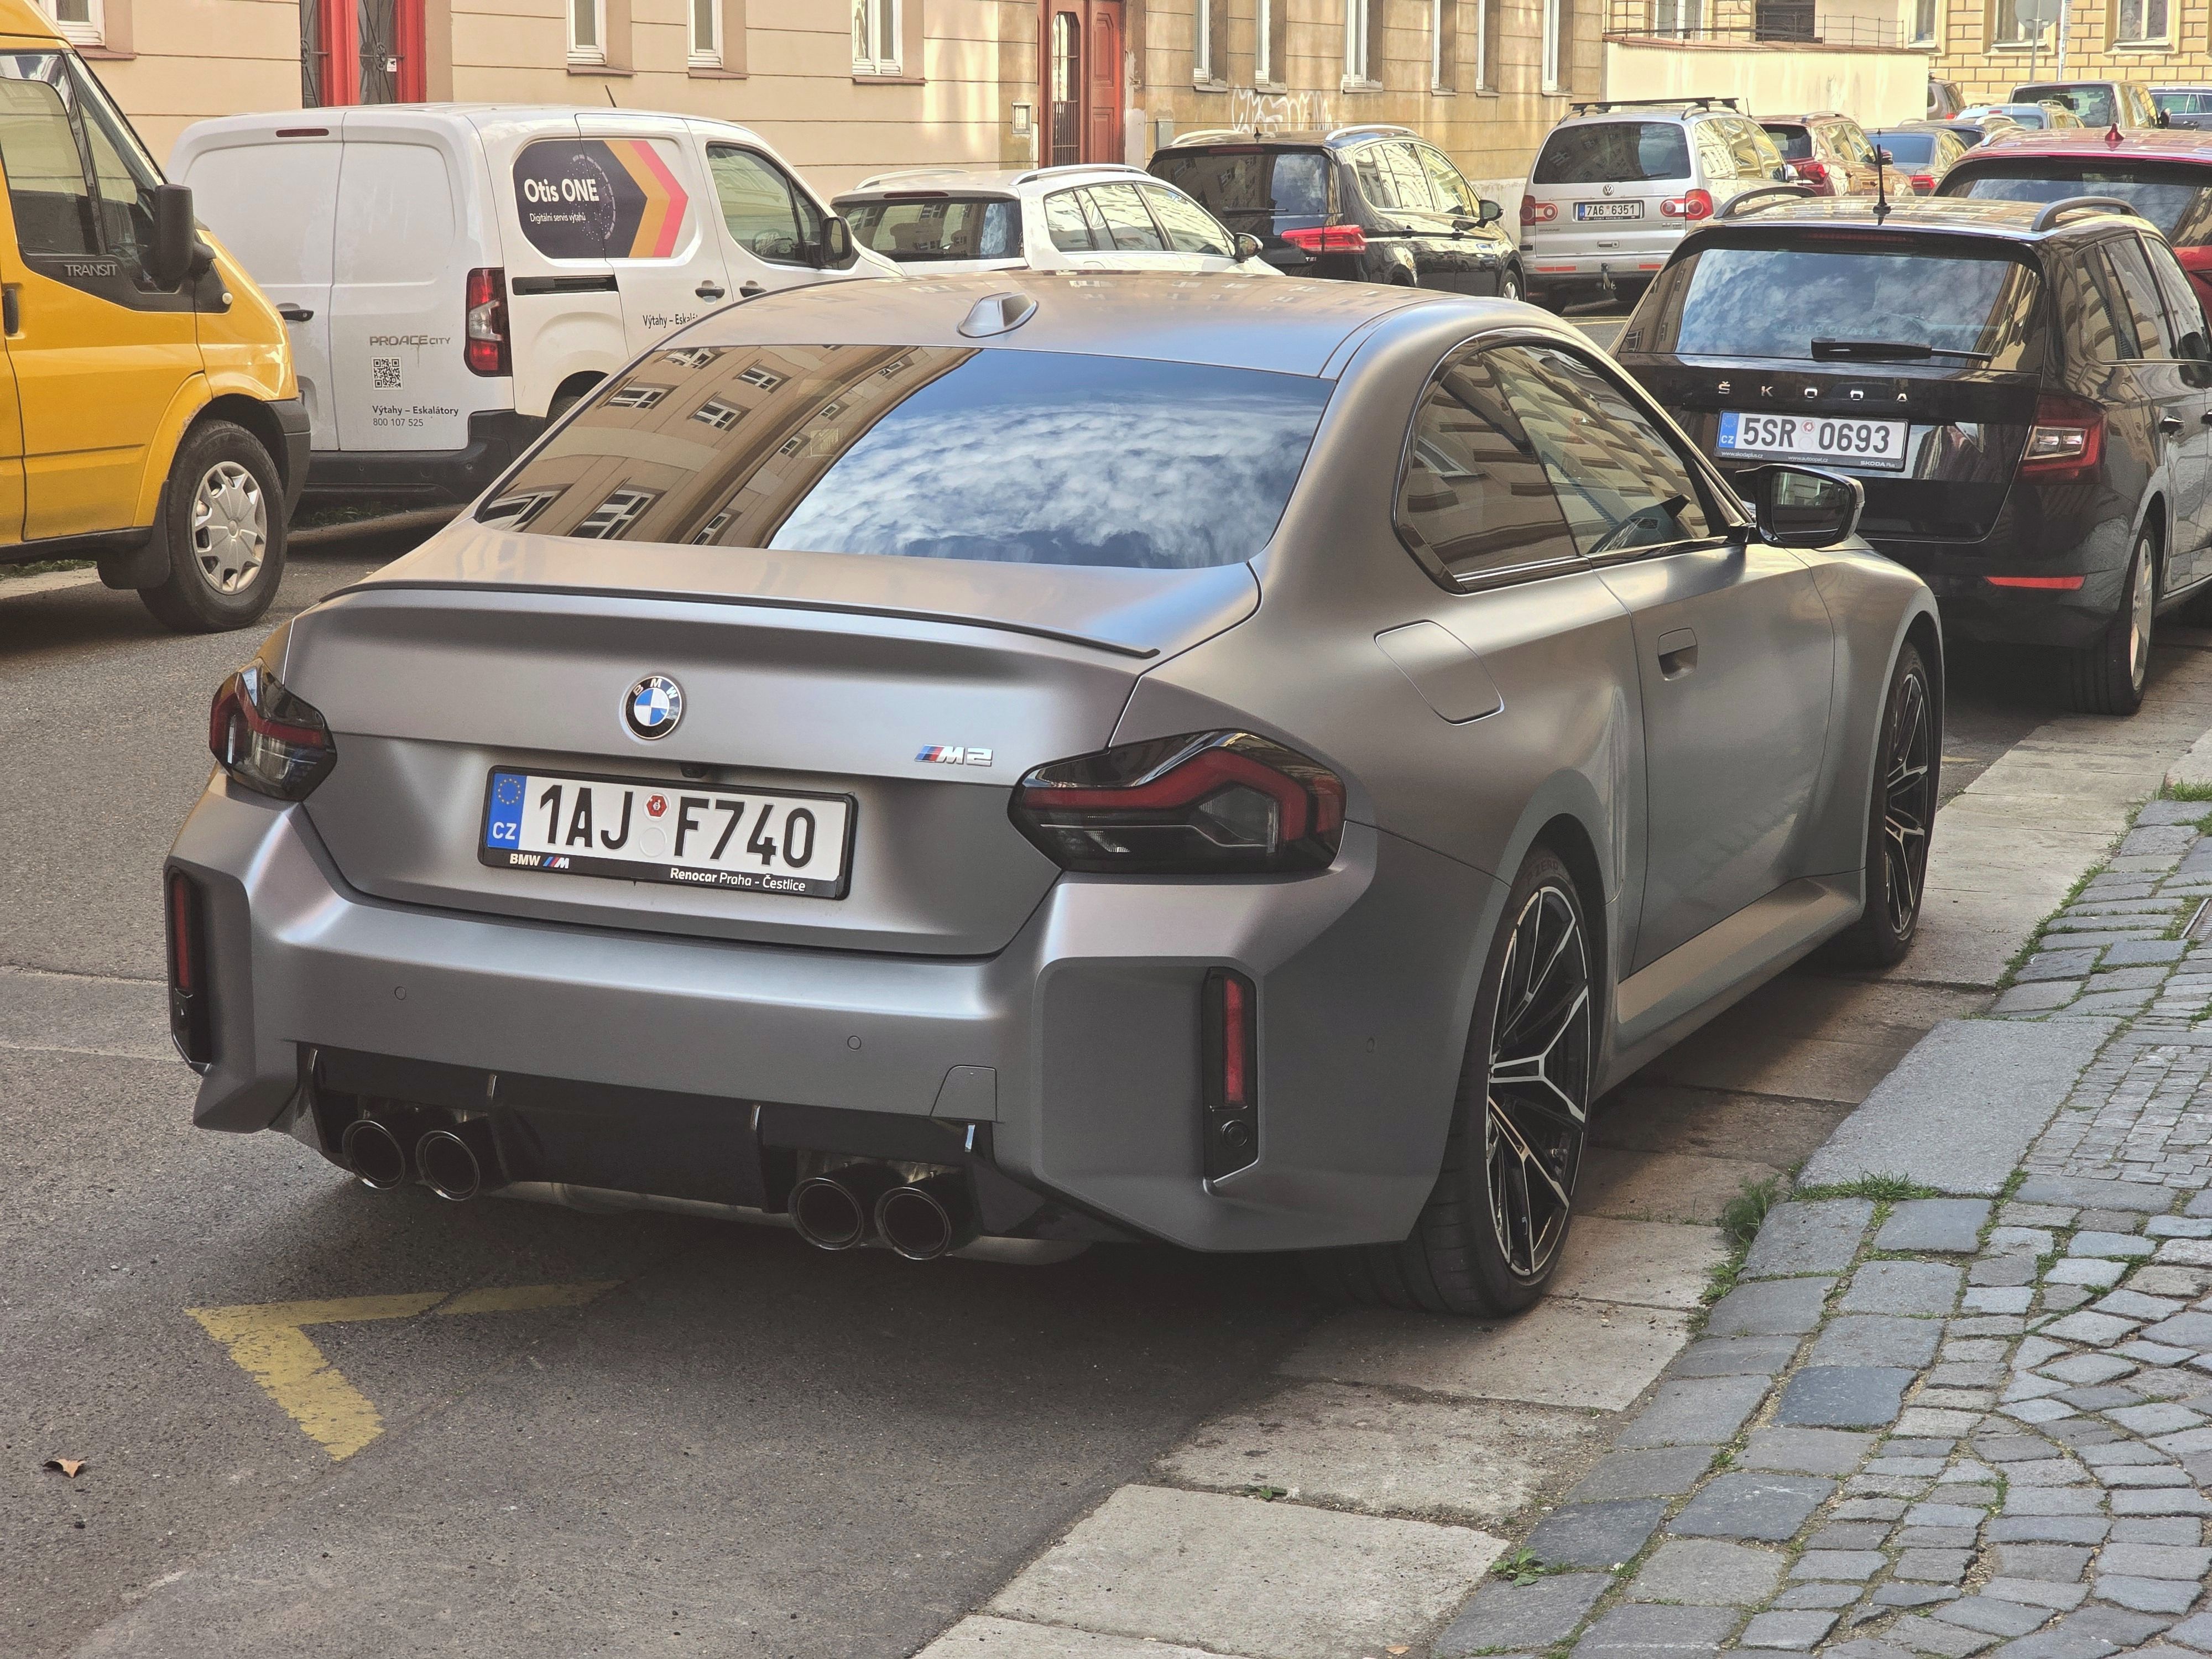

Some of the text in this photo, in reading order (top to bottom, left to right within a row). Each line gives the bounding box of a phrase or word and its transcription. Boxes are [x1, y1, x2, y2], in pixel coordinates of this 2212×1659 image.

[524, 179, 599, 202] Otis ONE
[530, 212, 586, 224] Digitální servis výtahů
[1587, 205, 1635, 216] 7A6 6351
[65, 264, 117, 276] TRANSIT
[643, 314, 667, 329] Výtahy
[369, 335, 428, 346] PROACE
[1718, 380, 1908, 403] ŠKODA
[372, 405, 402, 415] Výtahy
[413, 406, 458, 417] Eskalátory
[1721, 435, 1734, 445] CZ
[1743, 417, 1891, 453] 5SR 0693
[1721, 451, 1764, 460] www.skodaplus.cz
[633, 678, 678, 699] BMW
[936, 746, 993, 766] M2
[492, 821, 516, 841] CZ
[539, 784, 817, 867] 1AJ F740
[509, 853, 541, 867] BMW
[670, 867, 717, 883] Renocar
[719, 872, 752, 886] Praha
[763, 874, 806, 891] Čestlice
